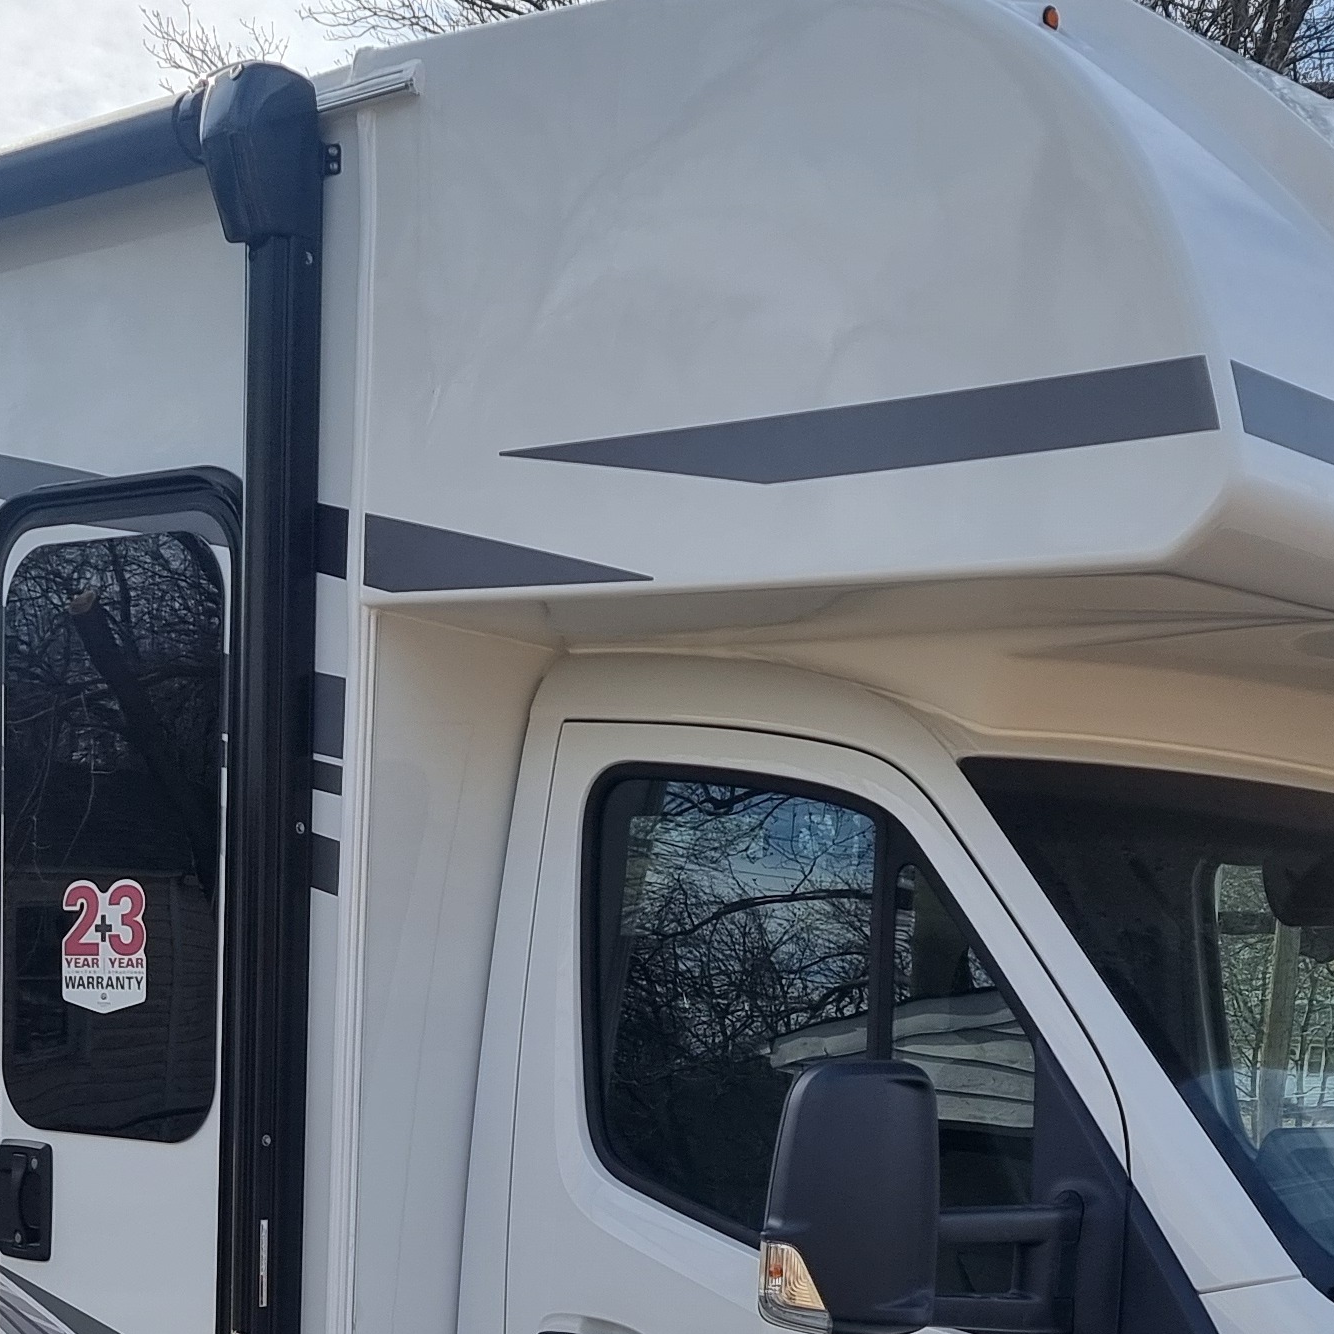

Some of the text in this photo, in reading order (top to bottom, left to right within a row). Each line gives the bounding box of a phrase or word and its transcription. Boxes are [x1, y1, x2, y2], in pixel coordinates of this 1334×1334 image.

[64, 957, 145, 969] YEAR YEAR
[64, 975, 144, 991] WARRANTY
